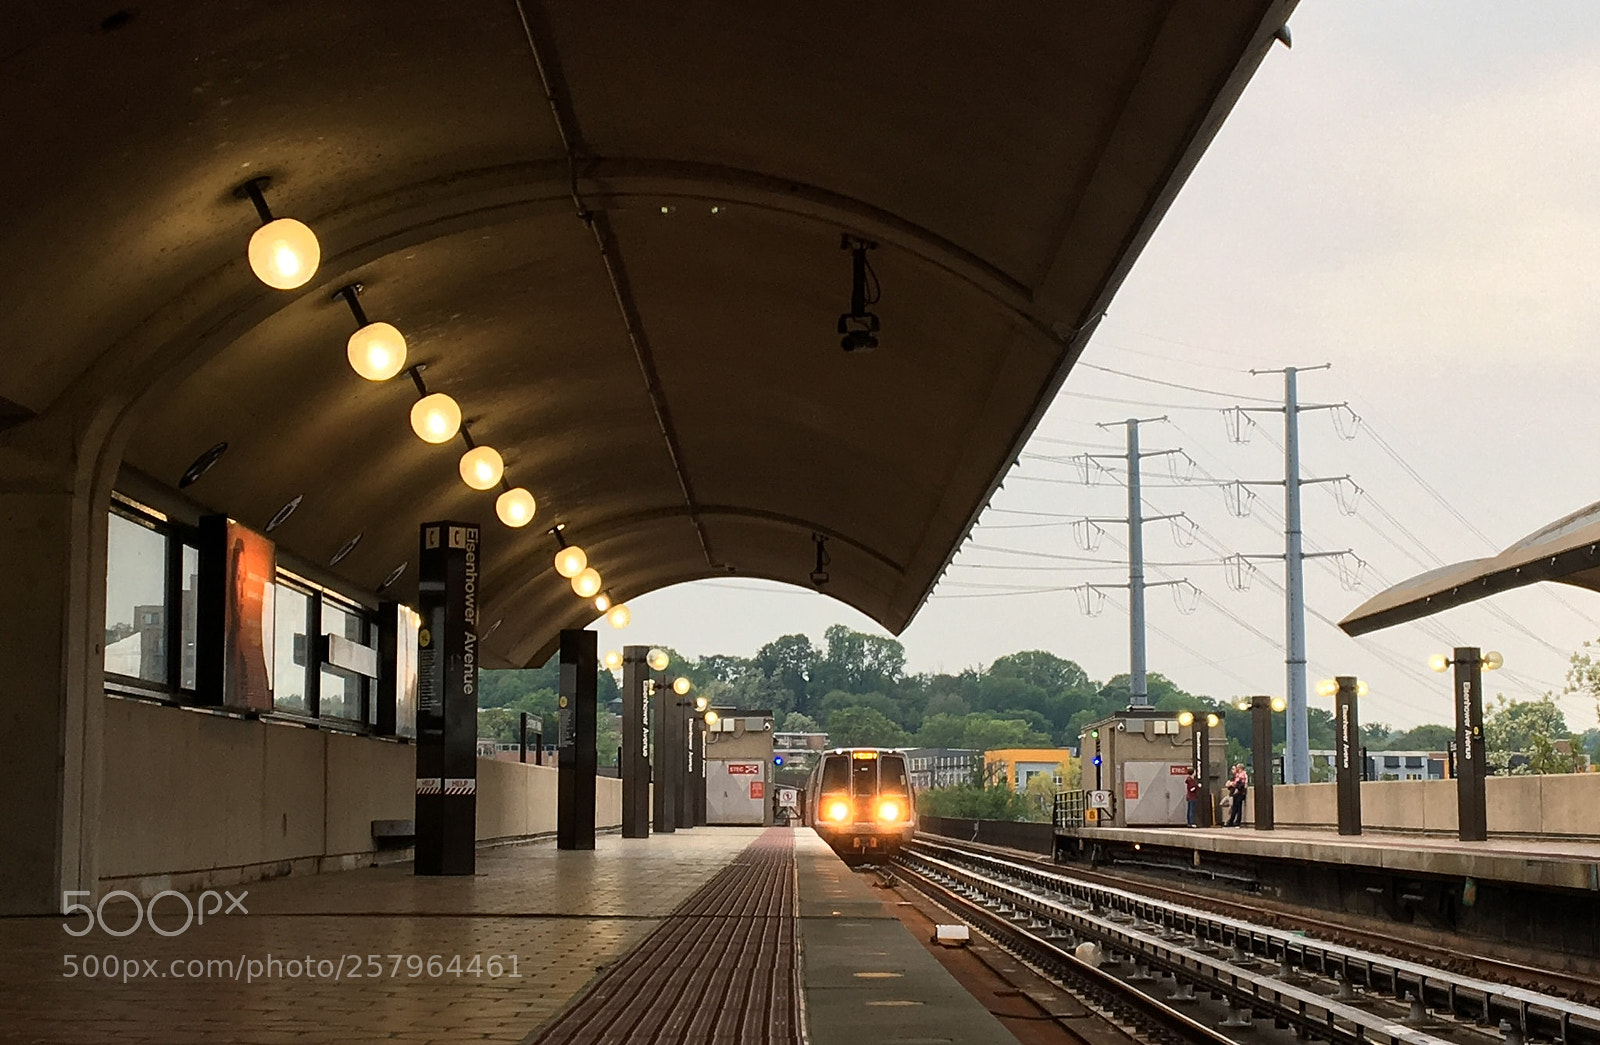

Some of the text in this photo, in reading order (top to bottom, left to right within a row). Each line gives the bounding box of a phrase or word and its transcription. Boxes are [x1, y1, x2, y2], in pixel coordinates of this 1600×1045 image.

[463, 528, 479, 695] Eisenhower Avenue
[1463, 681, 1473, 760] Eisenhower Avenue
